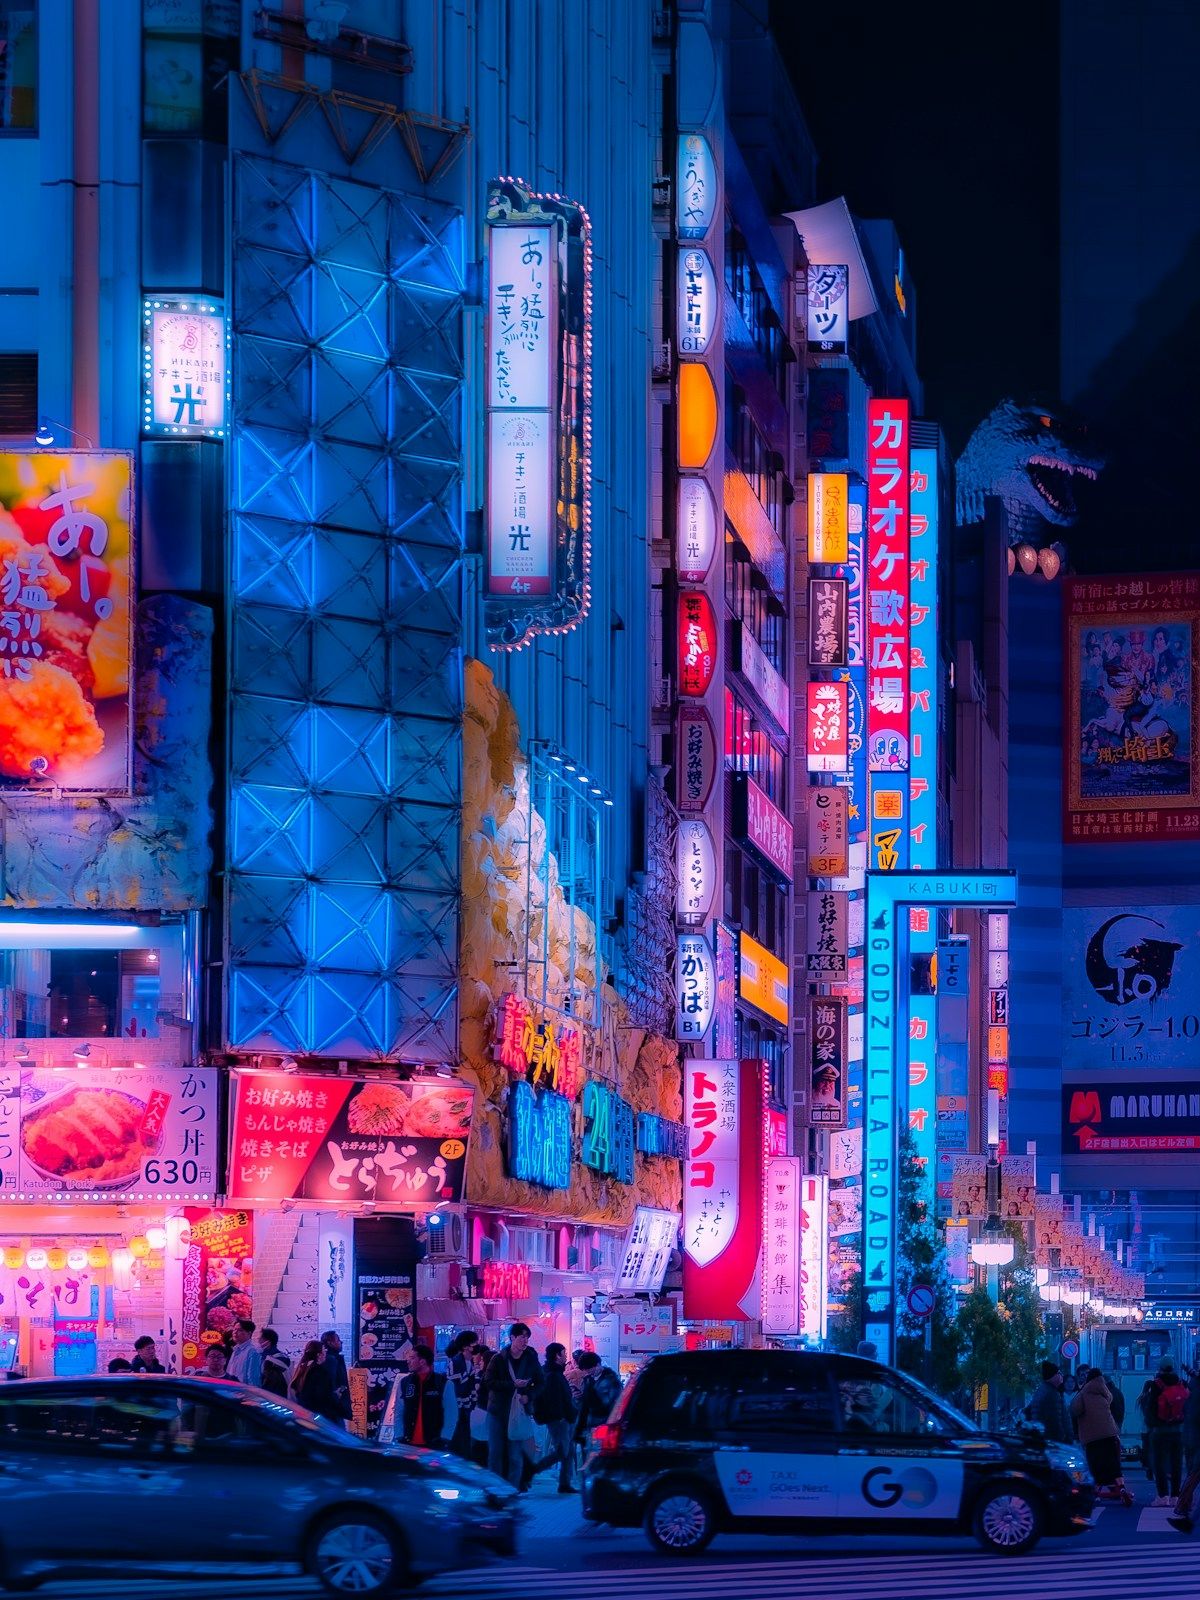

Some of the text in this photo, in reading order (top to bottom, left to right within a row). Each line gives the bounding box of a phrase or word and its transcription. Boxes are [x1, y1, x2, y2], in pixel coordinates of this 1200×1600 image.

[685, 228, 700, 237] 7F
[686, 270, 703, 326] ヤキトリ
[815, 269, 838, 335] ダーツ
[682, 337, 706, 350] 6F
[171, 358, 215, 368] HIKARI
[159, 368, 221, 384] チキン酒場
[170, 383, 207, 425] 光
[513, 452, 527, 519] チキン酒場
[508, 524, 532, 551] 光
[686, 542, 700, 558] 光
[870, 411, 905, 715] カラオケ歌広場
[510, 576, 532, 594] 4F
[685, 570, 699, 581] 4F
[1071, 578, 1199, 600] 新宿にお越しの皆様
[0, 553, 58, 682] 猛烈に
[814, 582, 840, 654] 山内農場
[703, 655, 712, 678] 3F
[826, 699, 843, 741] 焼肉屋
[1097, 732, 1175, 764] 翔んで埼玉
[686, 723, 703, 800] お好み焼き
[817, 757, 837, 770] 4F
[1071, 811, 1158, 825] 日本埼玉化計画
[1165, 814, 1200, 828] 11.23
[817, 858, 838, 872] 3F
[683, 913, 701, 924] 1F
[817, 893, 838, 953] お好み焼
[681, 943, 703, 954] 新宿
[808, 956, 844, 971] 大阪家
[680, 954, 704, 1014] かっぱ
[996, 990, 1006, 1018] ダーツ
[682, 1021, 701, 1033] B1
[815, 1005, 838, 1060] 海の家
[1071, 1014, 1200, 1040] ゴジラ-1.0
[1110, 1045, 1144, 1063] 11.3
[244, 1089, 329, 1109] お好み焼き
[720, 1063, 737, 1132] 大衆酒場
[868, 938, 891, 1250] GODZILLA ROAD
[1110, 1094, 1200, 1118] MARUHAN
[144, 1094, 166, 1134] 大人気
[178, 1073, 206, 1157] かつ丼
[243, 1114, 328, 1134] もんじゃ焼き
[690, 1071, 718, 1188] トラノコ
[240, 1139, 310, 1159] 焼きそば
[341, 1141, 386, 1151] お好み焼き
[444, 1143, 461, 1156] 2F
[240, 1166, 274, 1184] ピザ
[327, 1140, 448, 1193] とらぢゅう
[23, 1180, 62, 1189] Katudon
[690, 1198, 714, 1248] やきとん
[710, 1187, 731, 1237] やきとり
[773, 1199, 789, 1266] 珈琲茶館
[17, 1273, 89, 1310] そば
[182, 1244, 202, 1342] 食べ飲み放題
[770, 1273, 791, 1296] 集
[774, 1314, 785, 1322] 2F
